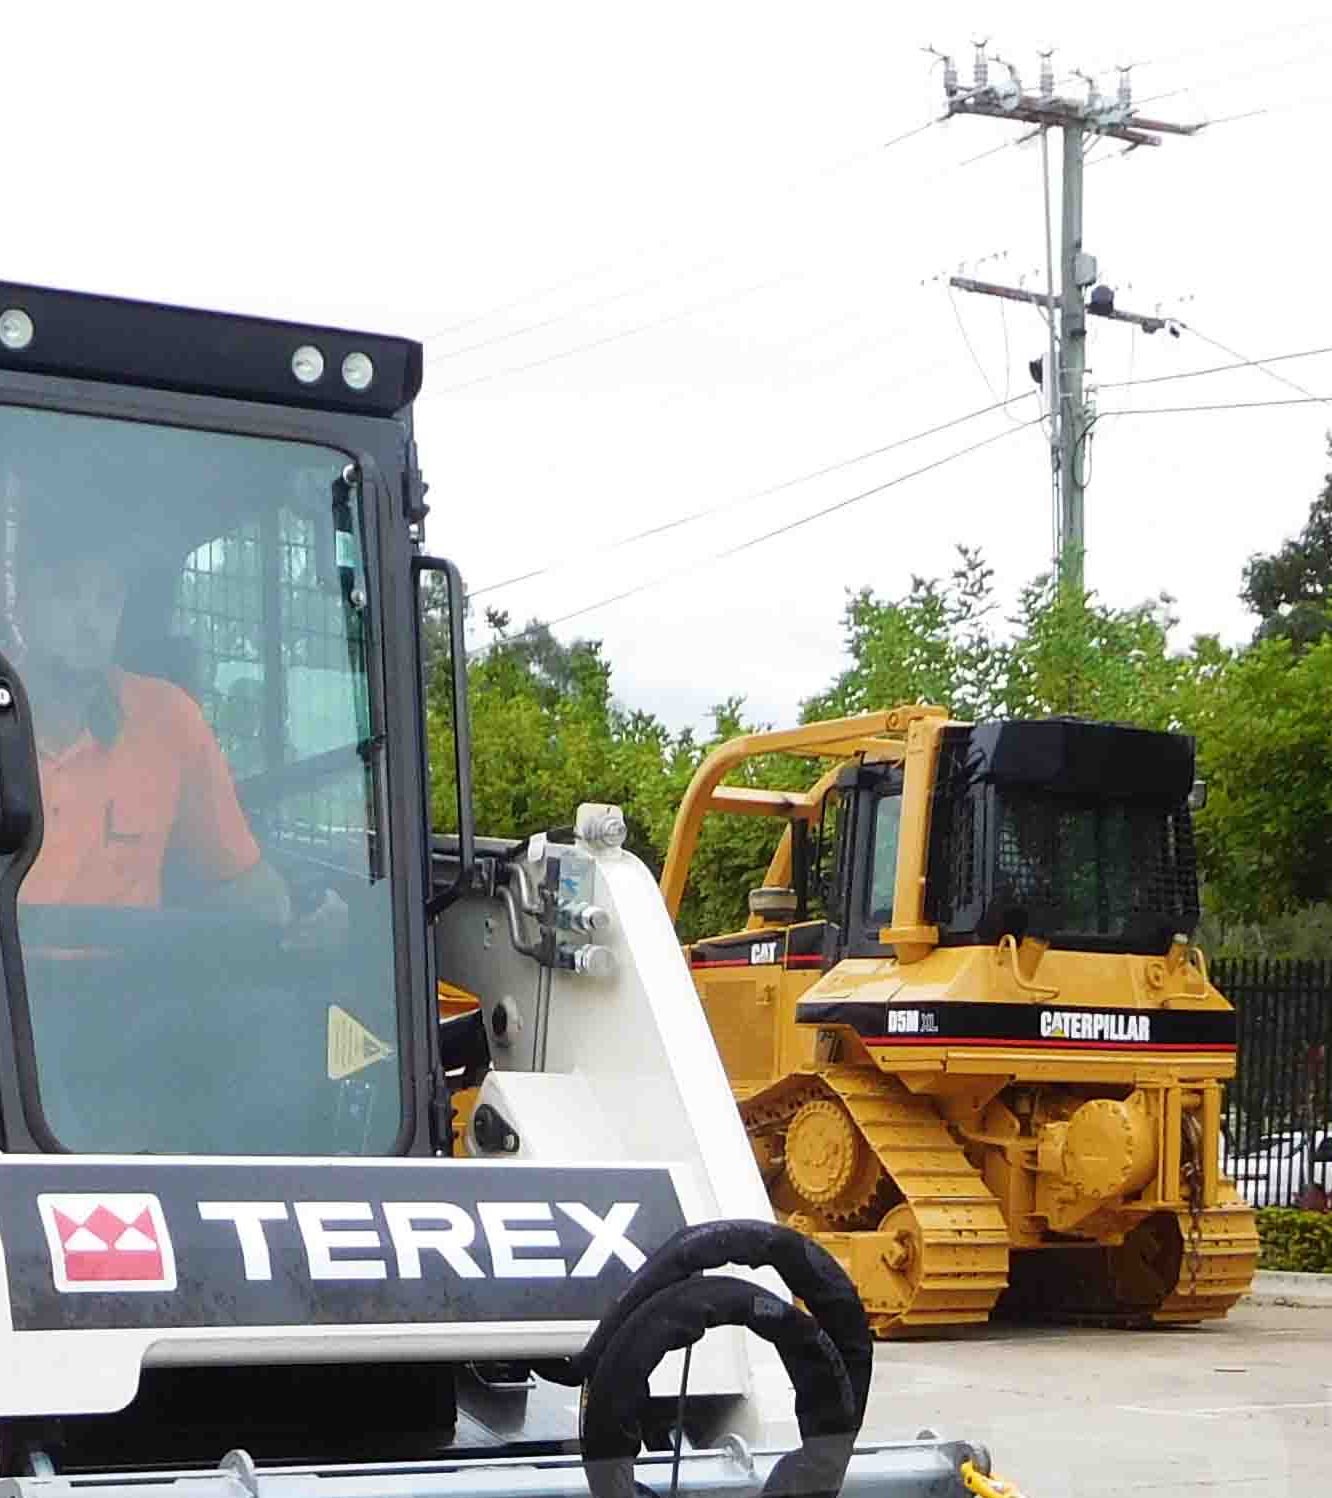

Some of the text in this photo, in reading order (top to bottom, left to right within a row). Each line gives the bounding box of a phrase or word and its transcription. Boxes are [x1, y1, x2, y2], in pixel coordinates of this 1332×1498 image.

[750, 942, 777, 965] CAT
[887, 1009, 919, 1033] D5M
[1040, 1011, 1150, 1041] CATERPILLAR
[197, 1201, 648, 1281] TEREX
